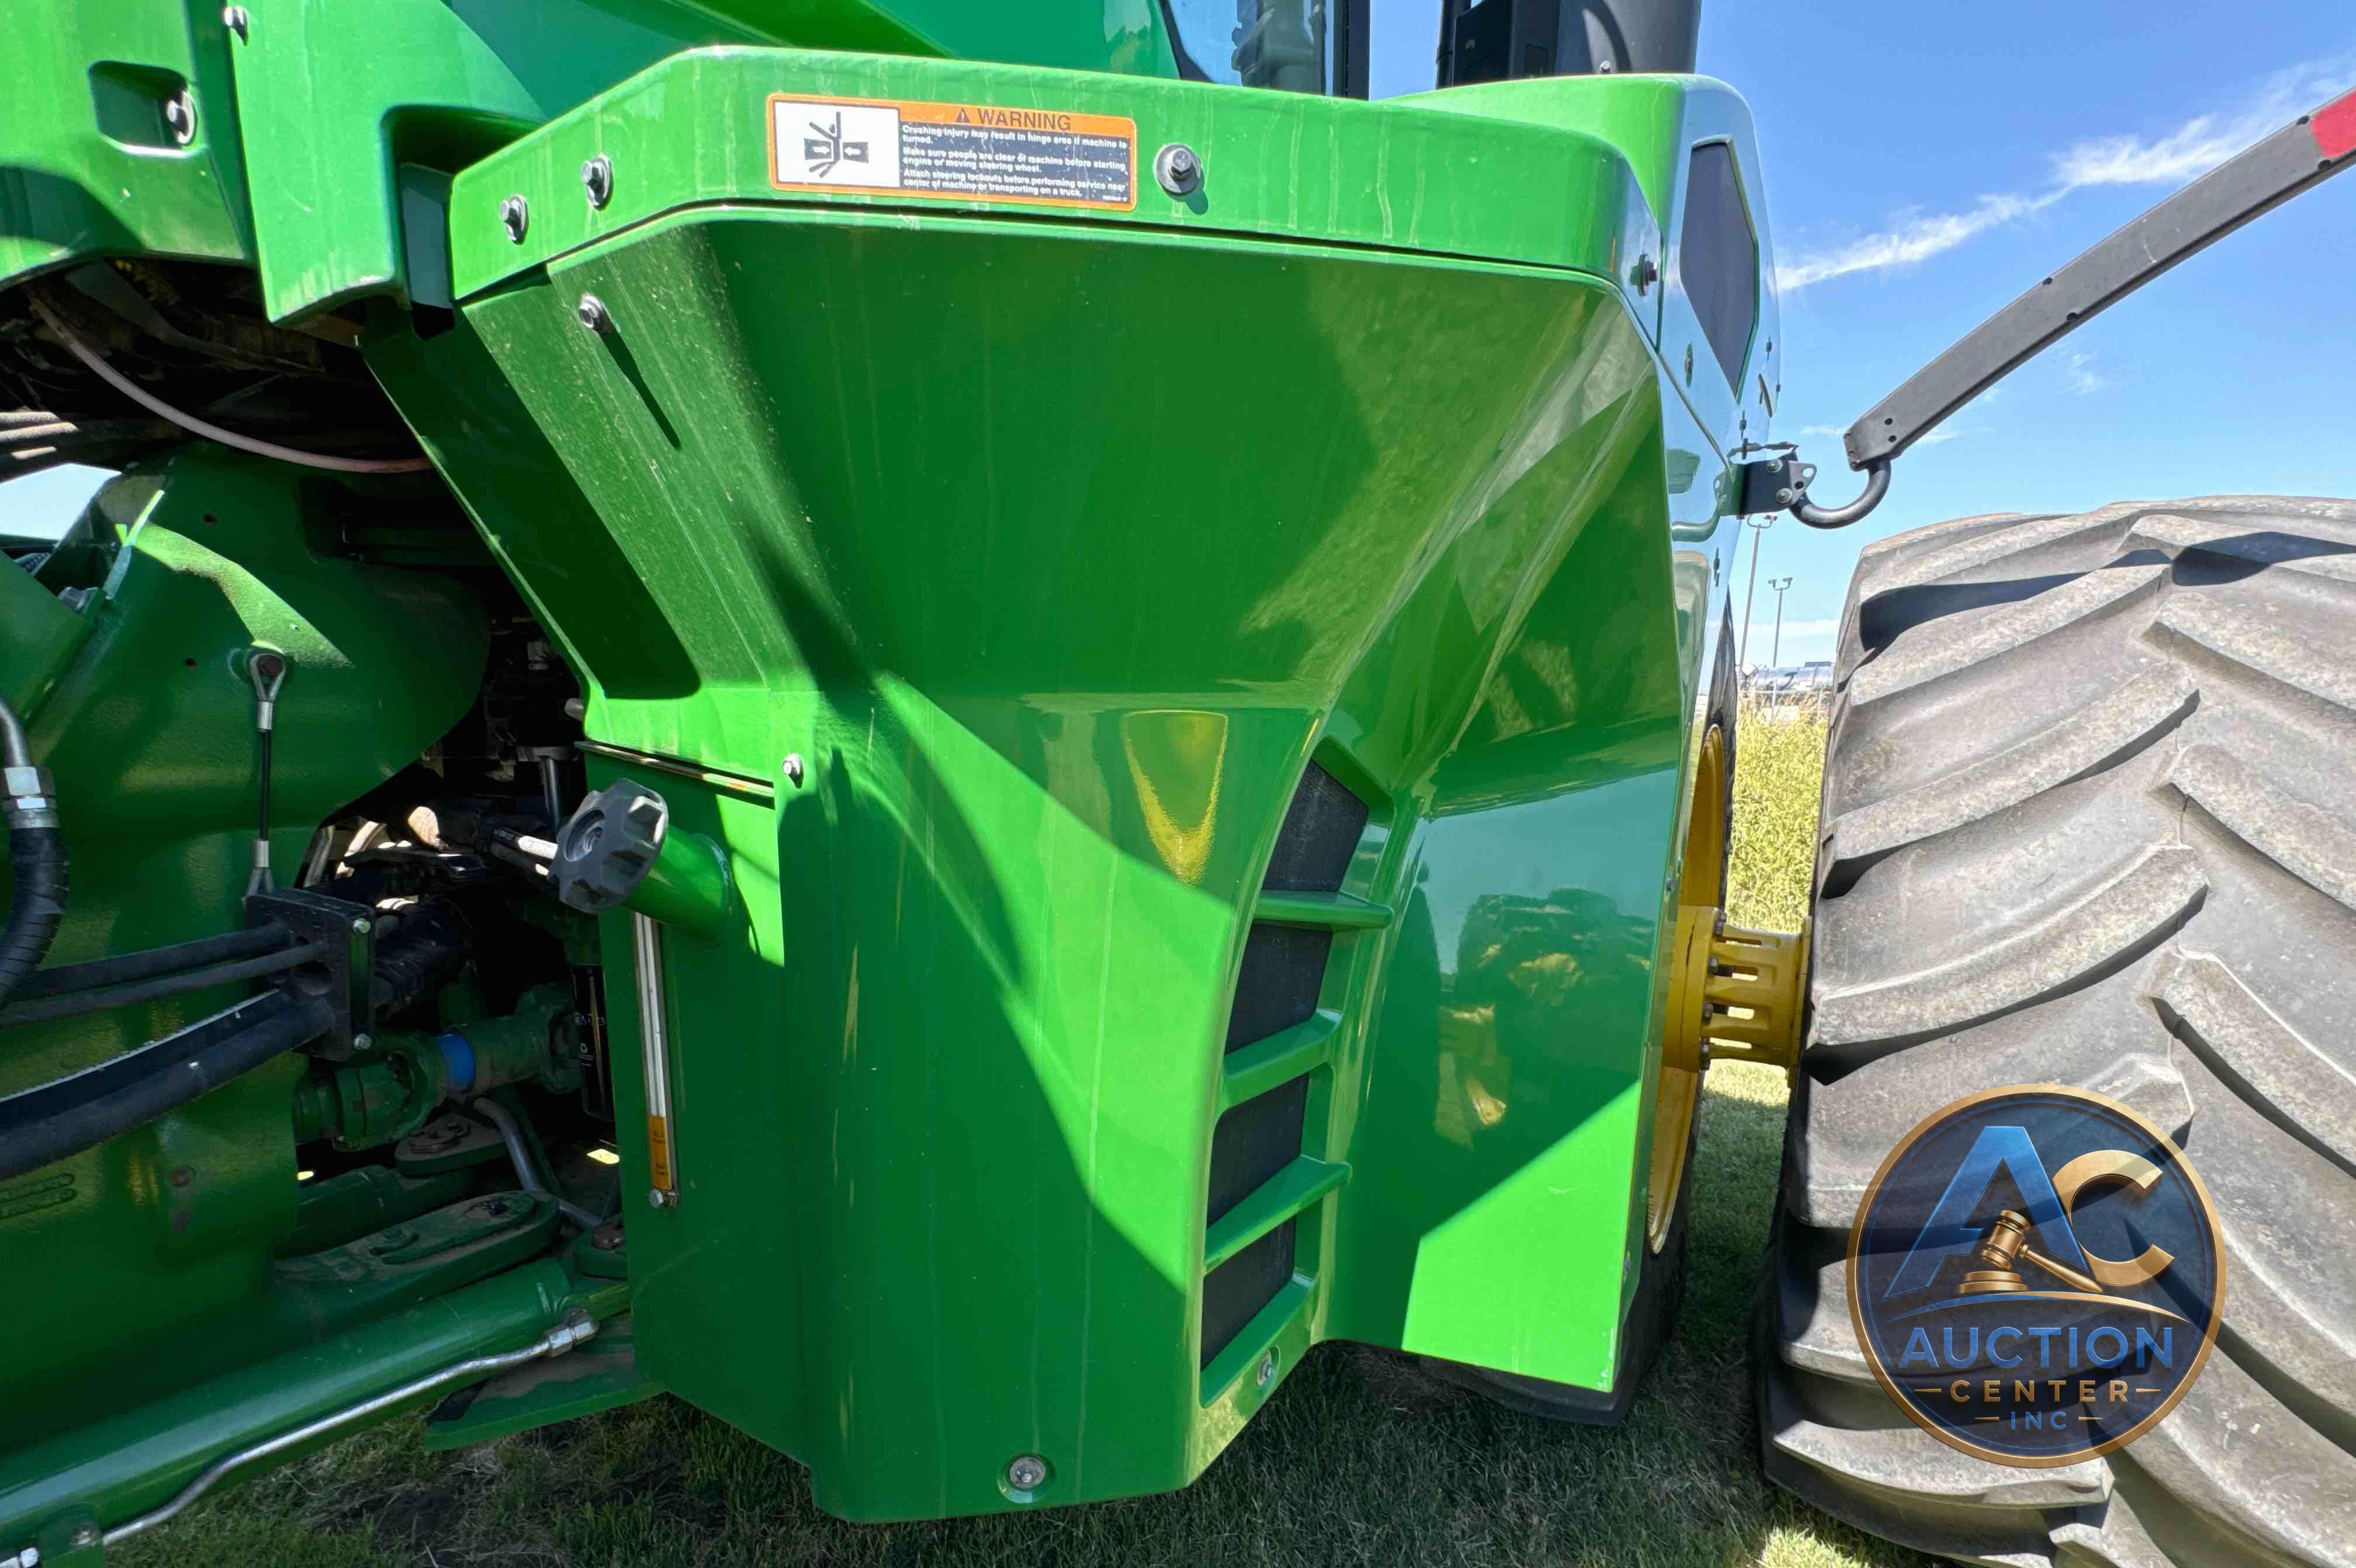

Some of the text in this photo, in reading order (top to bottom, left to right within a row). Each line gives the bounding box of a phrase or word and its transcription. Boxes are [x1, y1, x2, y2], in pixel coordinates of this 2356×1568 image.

[978, 108, 1071, 130] WARNING
[902, 125, 1127, 148] Crushing injury may result in hinge area if machine is
[903, 135, 933, 144] turned.
[903, 147, 925, 155] Make
[948, 150, 977, 159] people
[995, 152, 1015, 161] clear
[1028, 156, 1063, 165] machine
[1065, 158, 1092, 167] before
[1093, 161, 1125, 171] starting
[903, 157, 932, 166] engine
[946, 159, 976, 169] moving
[979, 162, 1013, 172] steering
[1015, 163, 1042, 172] wheel.
[904, 169, 1125, 192] Attach steering lockouts before performing service near
[904, 179, 929, 187] center
[932, 179, 941, 188] of
[943, 181, 975, 190] machine
[989, 183, 1038, 195] transporting
[1059, 188, 1082, 196] truck.
